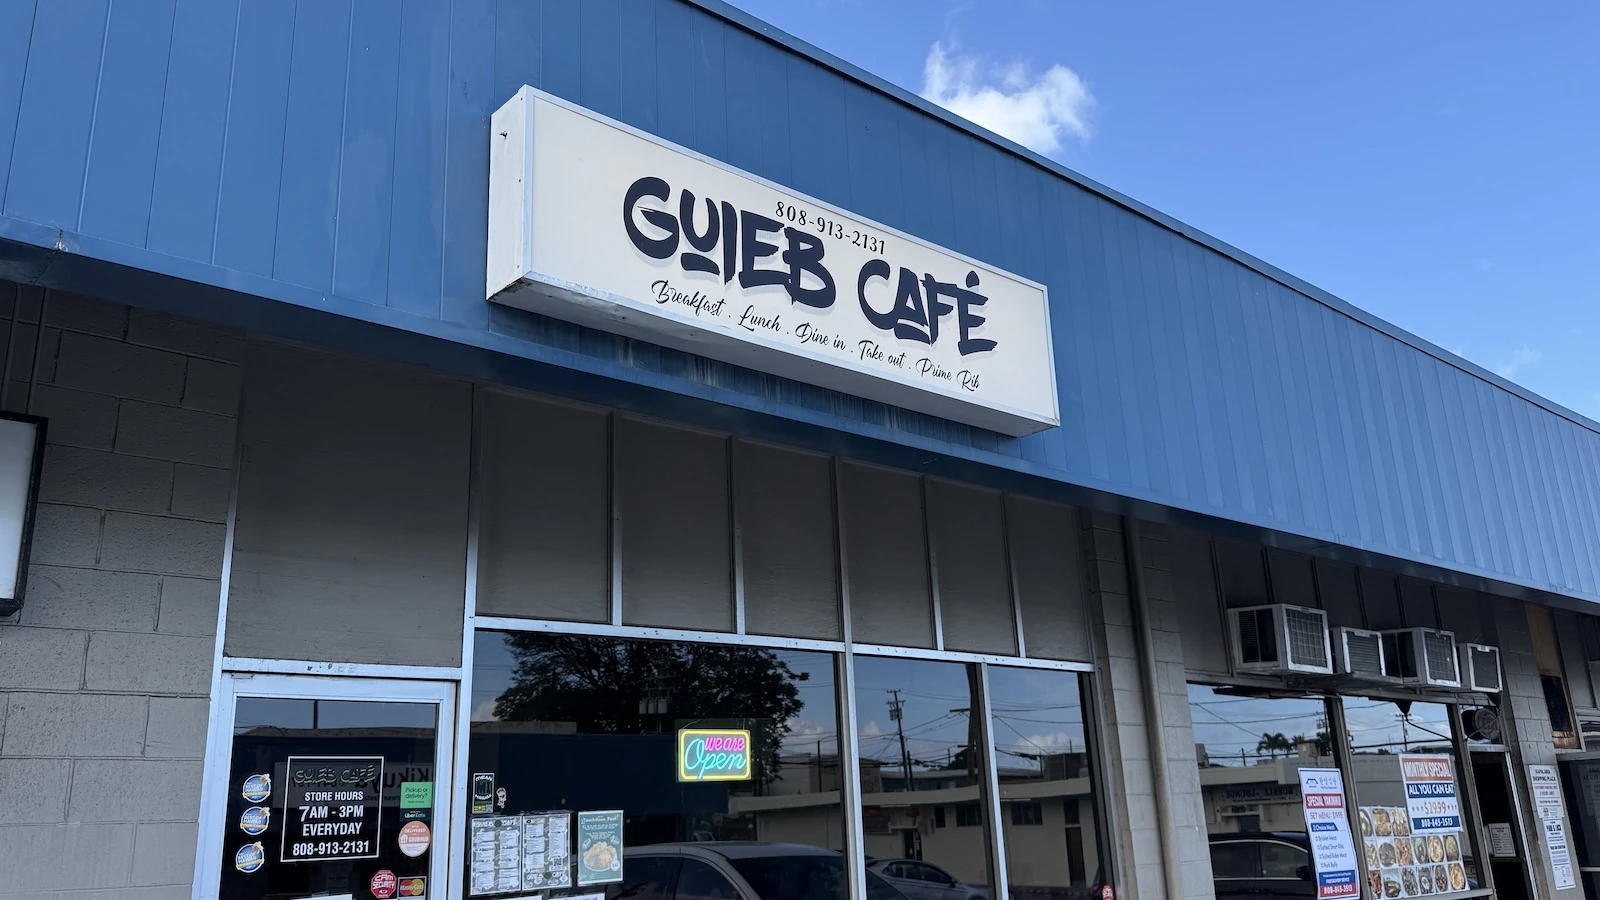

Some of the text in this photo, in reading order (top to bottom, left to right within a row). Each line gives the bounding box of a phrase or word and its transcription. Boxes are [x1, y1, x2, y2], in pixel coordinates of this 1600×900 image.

[775, 201, 885, 255] 808-913-2131
[624, 176, 836, 308] GUIEB
[651, 279, 981, 392] Breakfast Lunch Dine in Take out Prime Rib
[704, 736, 746, 751] we are
[684, 738, 747, 779] Open
[1429, 761, 1452, 777] SPECIAL
[305, 792, 332, 802] STORE
[335, 791, 364, 801] HOURS
[1409, 783, 1454, 794] ALL YOU CAN EAT
[299, 806, 328, 822] 7AM
[339, 805, 364, 818] 3PM
[303, 822, 362, 837] EVERYDAY
[293, 841, 369, 856] 808-913-2131
